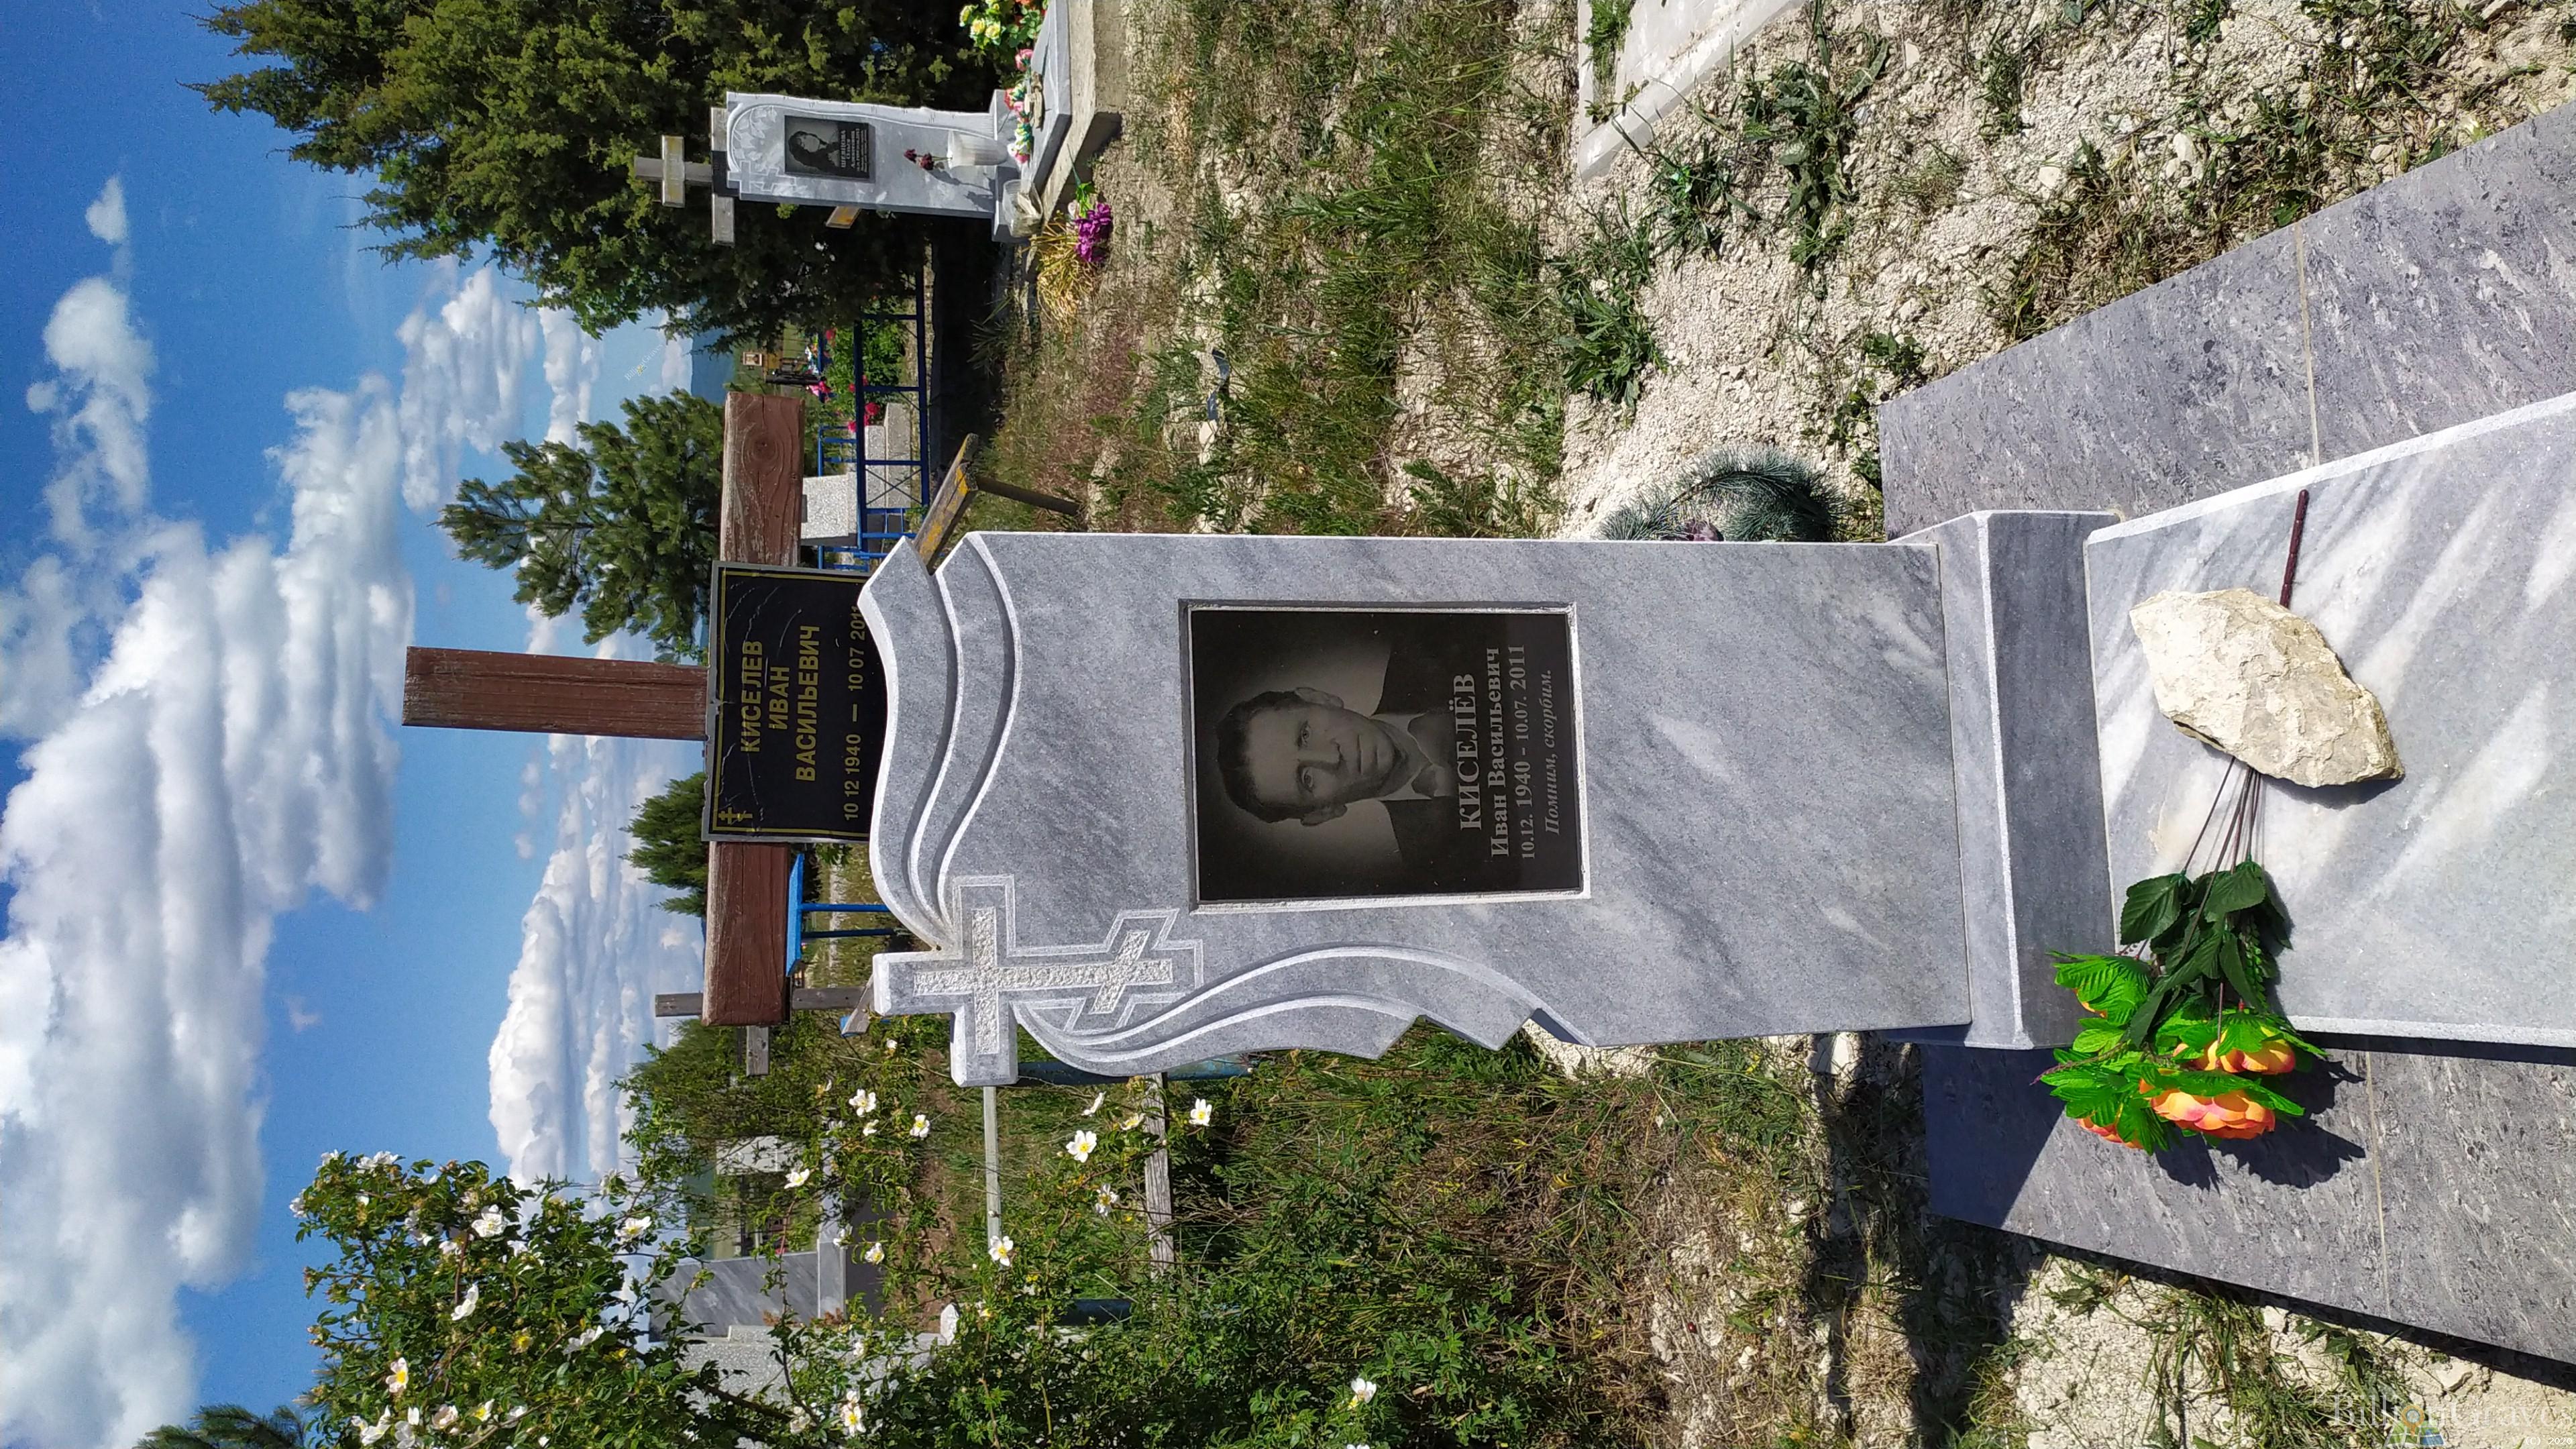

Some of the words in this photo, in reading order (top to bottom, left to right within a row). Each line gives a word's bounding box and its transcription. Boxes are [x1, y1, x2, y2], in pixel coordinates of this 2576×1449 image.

[849, 647, 865, 669] 07
[1507, 644, 1526, 690] 2011
[740, 641, 763, 753] КИСЕЛЕВ
[768, 665, 790, 730] ИВАН
[794, 625, 820, 782] ВАСИЛЬЕВИЧ
[848, 674, 864, 691] 10
[1486, 648, 1505, 788] Васильевич
[1514, 696, 1529, 741] 10.07.
[1539, 669, 1558, 748] скорбим.
[845, 734, 861, 774] 1940
[1449, 674, 1482, 830] КИСЕЛЁВ
[843, 780, 861, 797] 12
[1513, 761, 1533, 808] 1940
[1544, 753, 1560, 835] Помним,
[843, 802, 860, 821] 10
[1490, 794, 1509, 857] Иван
[1519, 814, 1536, 859] 10.12.
